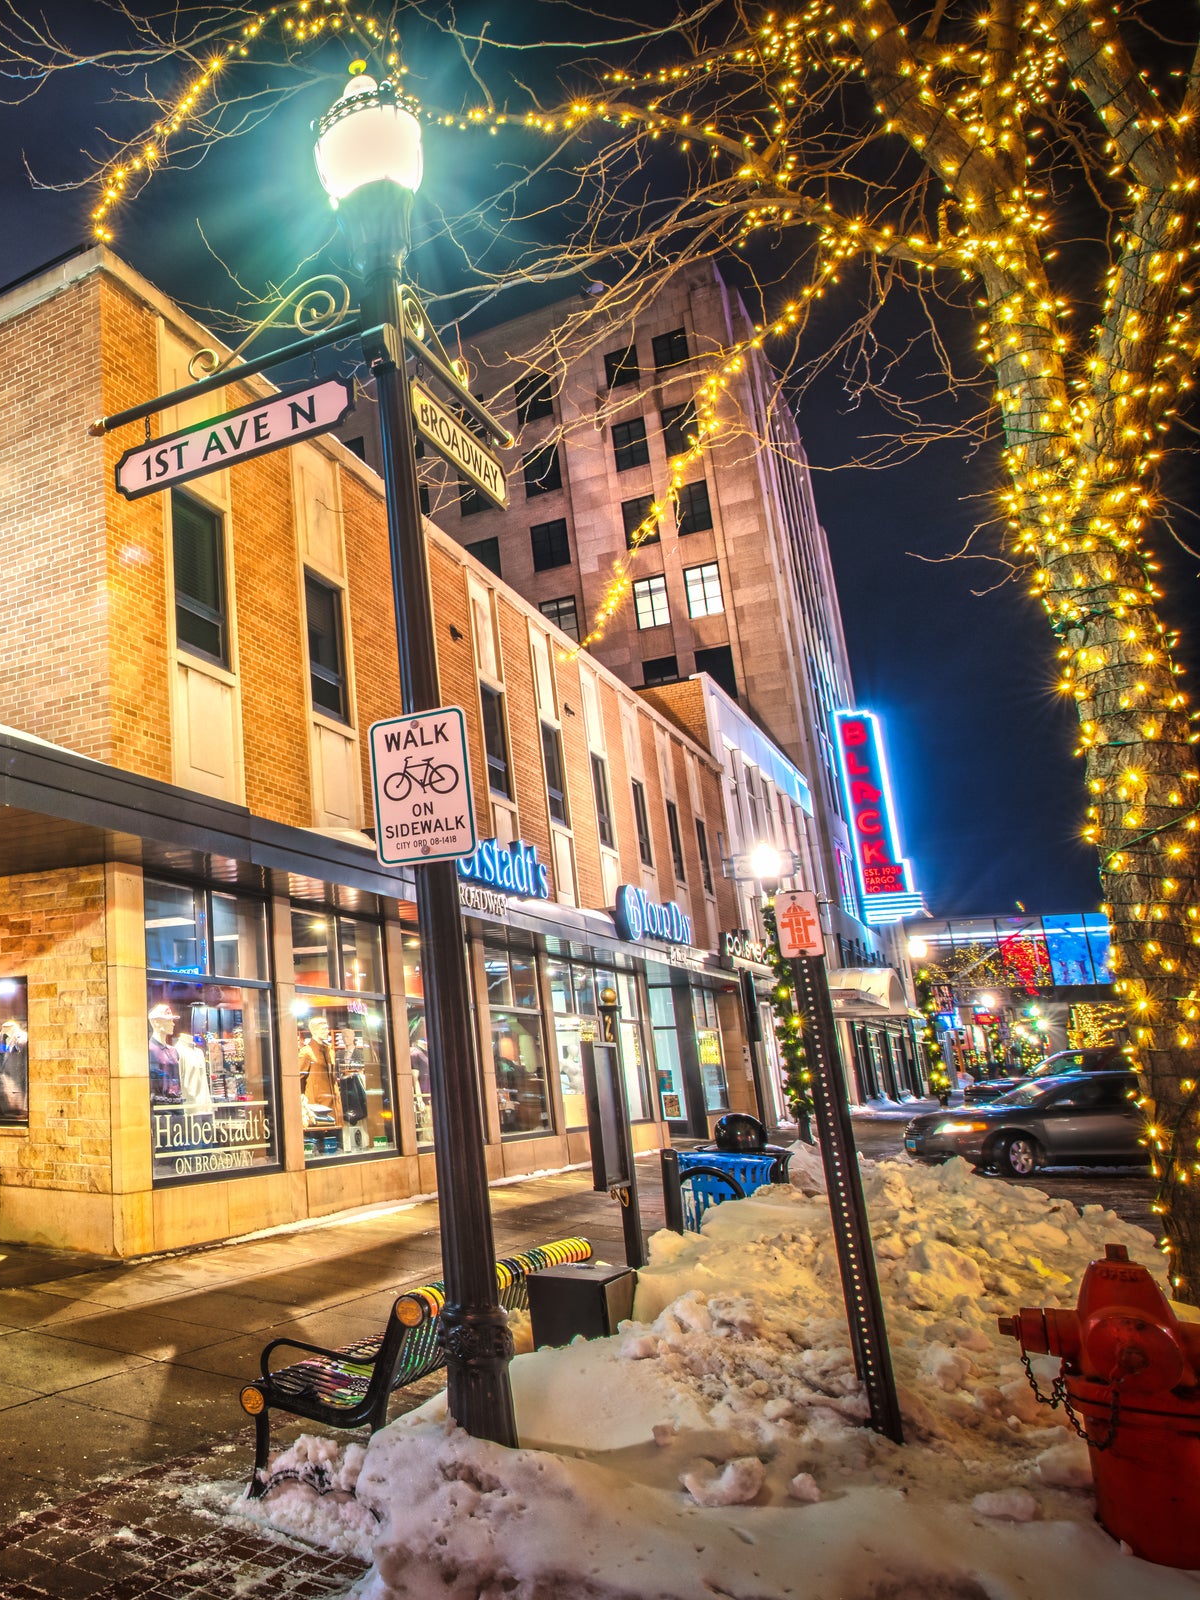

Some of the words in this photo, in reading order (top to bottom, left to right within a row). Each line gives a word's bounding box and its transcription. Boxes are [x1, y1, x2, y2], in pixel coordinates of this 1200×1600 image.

[142, 441, 189, 482] 1ST
[202, 411, 271, 461] AVE
[288, 395, 317, 430] N
[419, 402, 499, 494] BROADWAY
[384, 722, 449, 753] WALK
[841, 721, 889, 864] BLACK
[412, 801, 434, 817] ON
[385, 815, 466, 839] SIDEWALK
[396, 841, 410, 850] CITY
[413, 839, 428, 848] ORD
[430, 835, 457, 845] 08-1418
[457, 838, 549, 899] erstadt's
[863, 868, 881, 877] EST.
[865, 875, 895, 884] FARGO
[458, 884, 508, 916] ROADWAY
[154, 1110, 271, 1149] Halberstadt's
[175, 1156, 192, 1175] ON
[195, 1151, 254, 1172] BROADWAY
